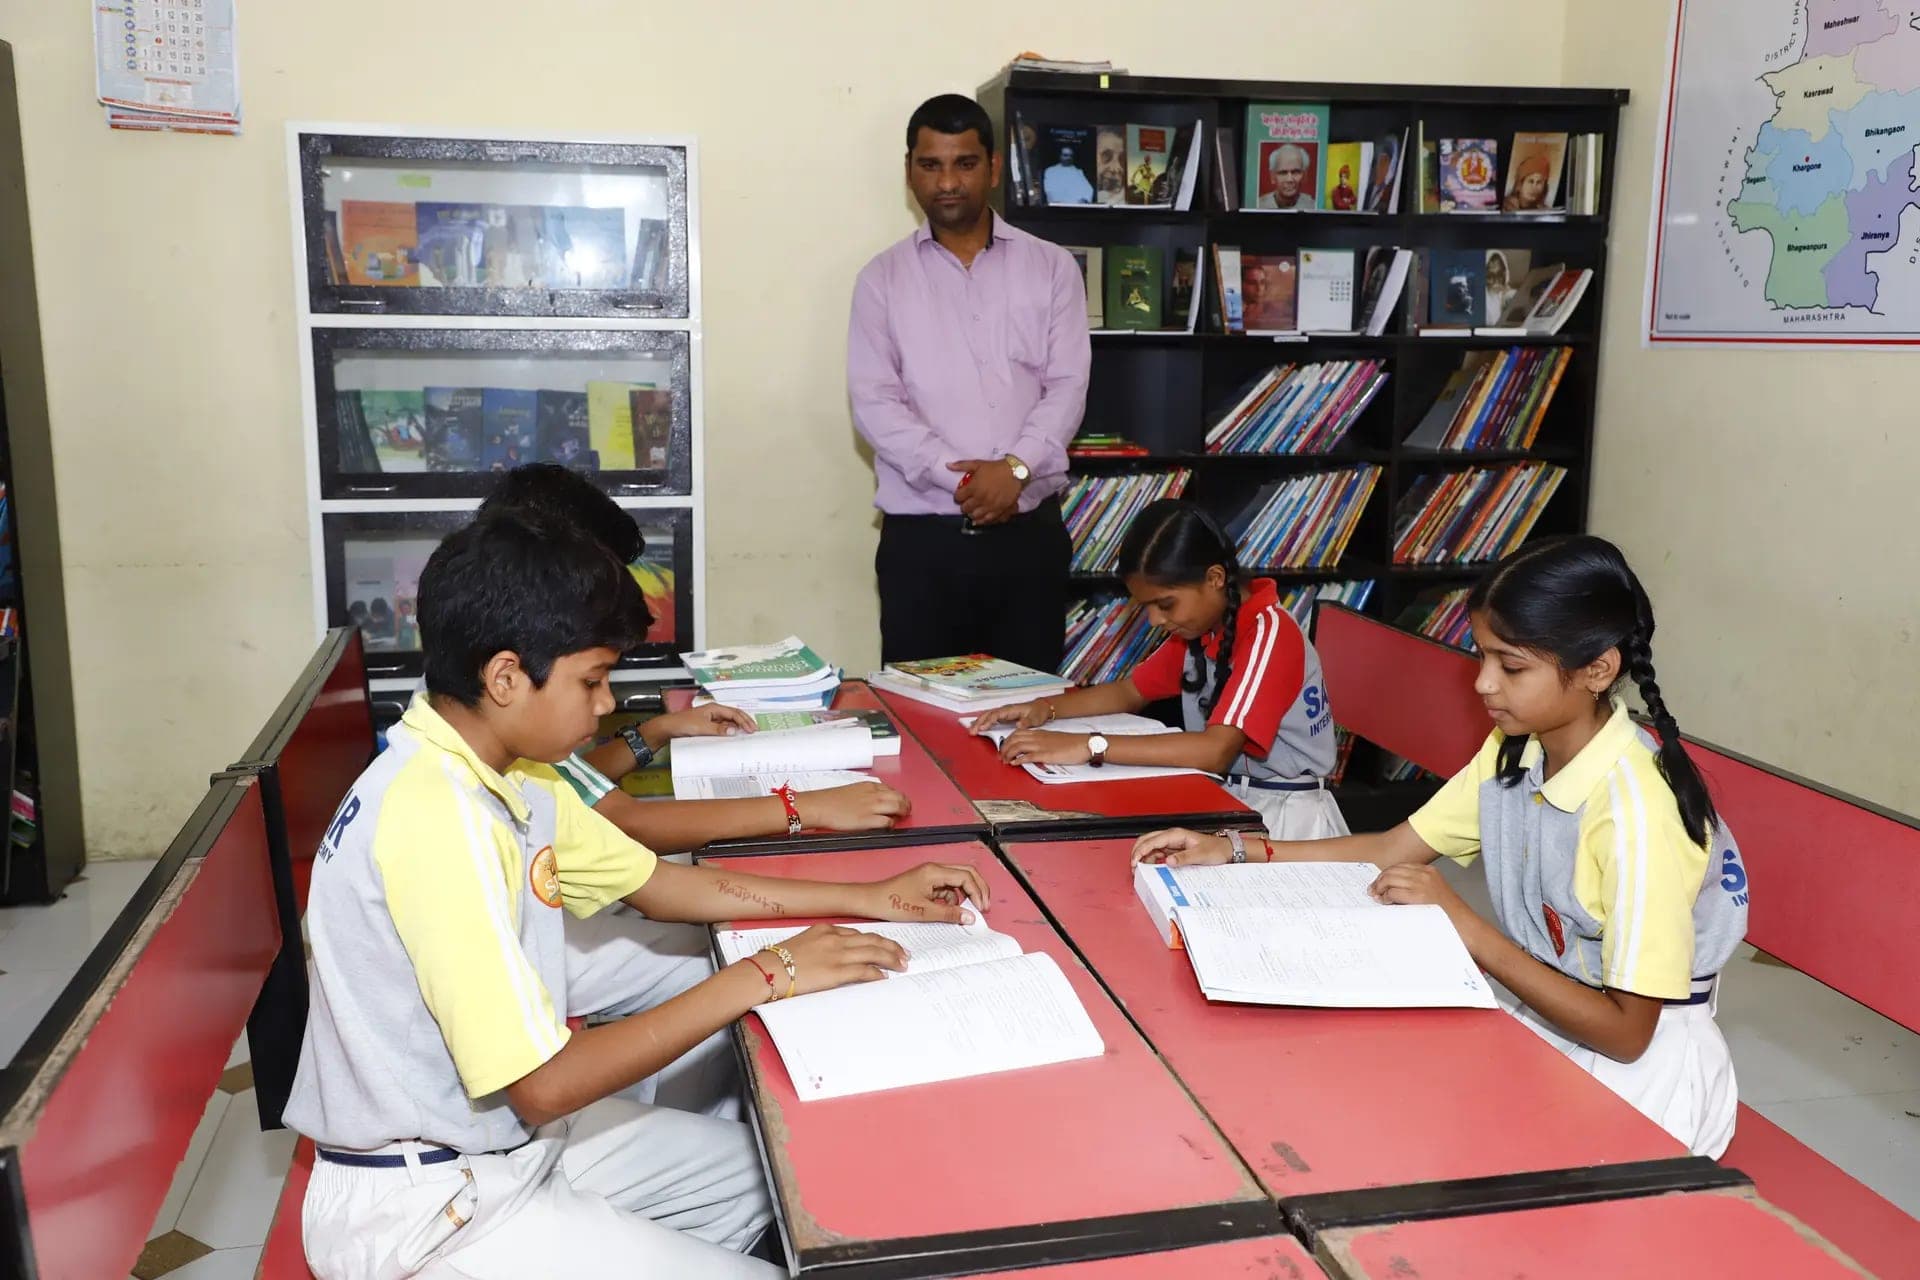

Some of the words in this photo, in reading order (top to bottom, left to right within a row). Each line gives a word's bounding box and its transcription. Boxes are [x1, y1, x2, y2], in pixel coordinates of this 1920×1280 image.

[1824, 15, 1860, 30] Maheshwar
[1764, 32, 1797, 62] DISTRICT
[1803, 86, 1834, 99] Kasrawad
[1864, 125, 1906, 137] Bhikangaon
[1792, 163, 1822, 172] Khargone
[1861, 231, 1890, 241] Jhiranya
[1783, 312, 1846, 323] MAHARASHTRA
